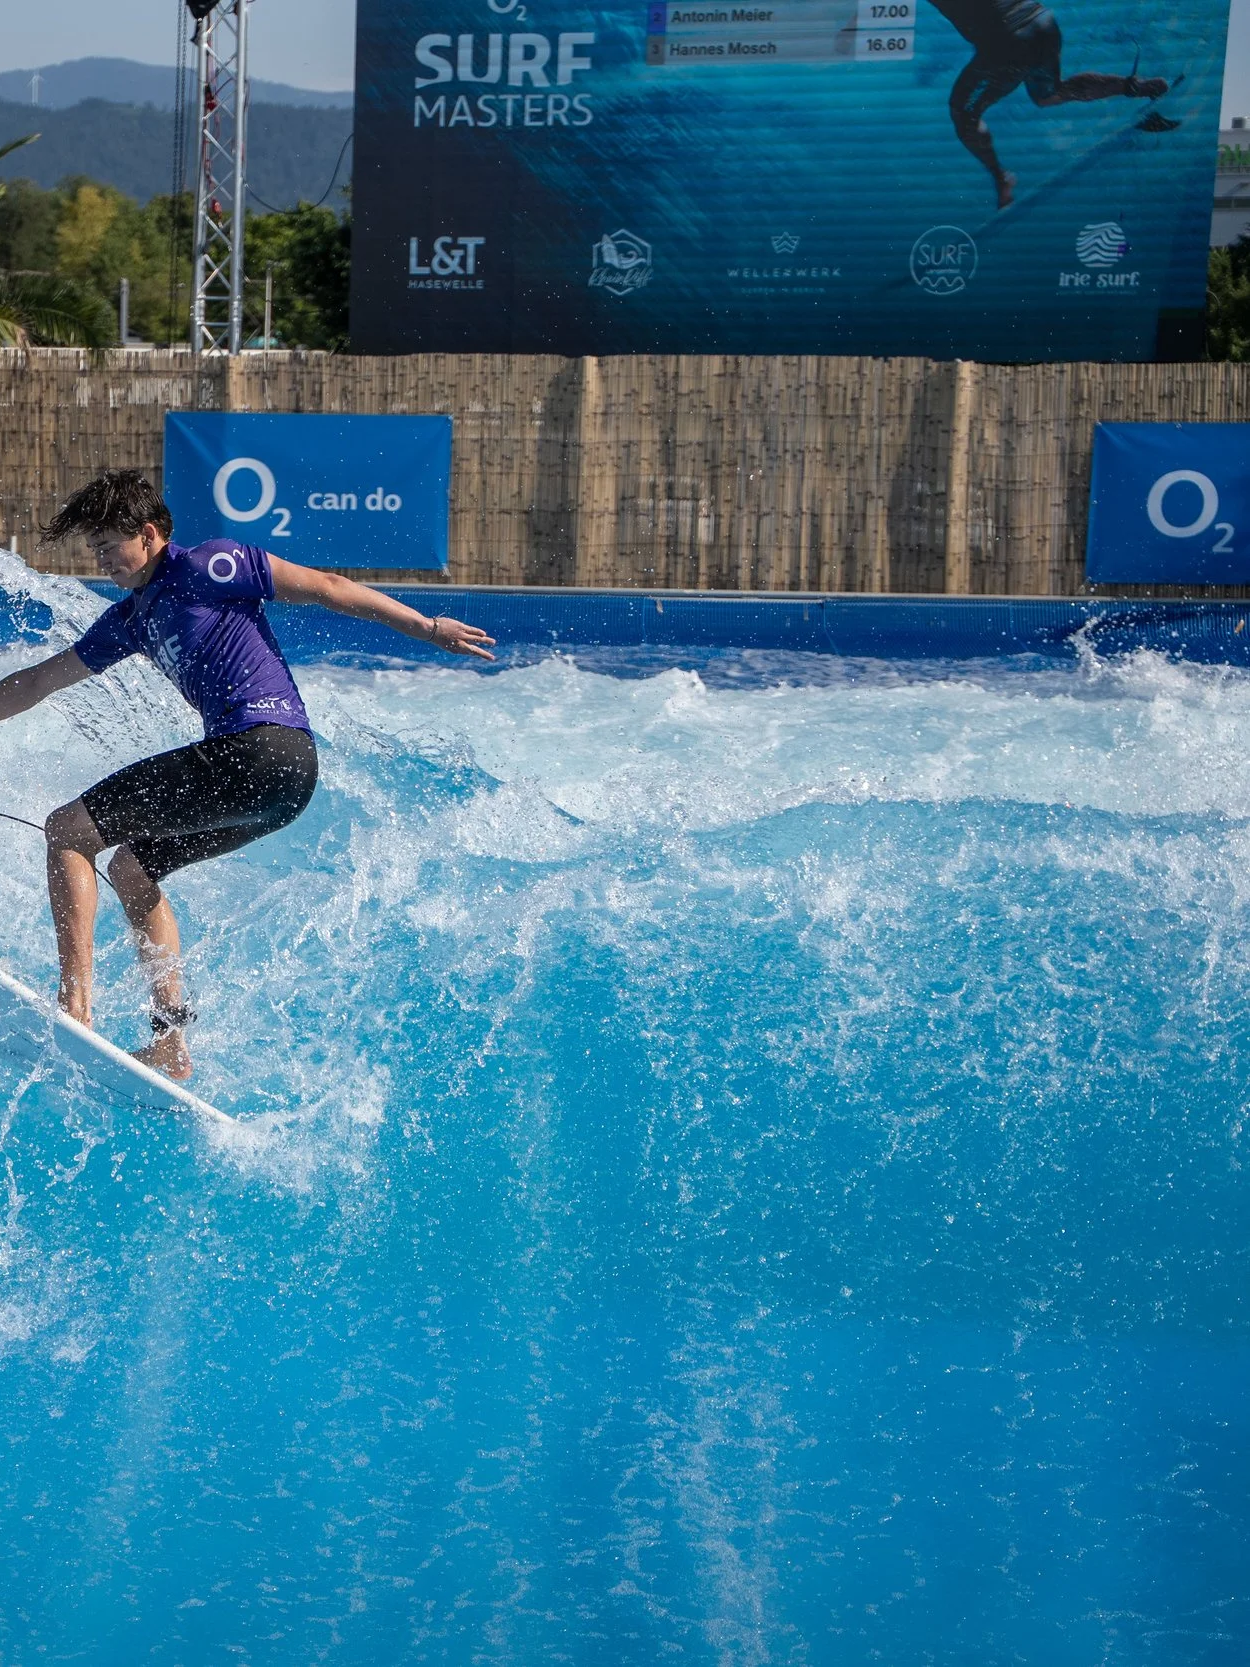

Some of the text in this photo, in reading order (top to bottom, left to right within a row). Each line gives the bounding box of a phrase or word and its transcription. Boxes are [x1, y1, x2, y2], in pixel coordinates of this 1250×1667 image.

[671, 9, 727, 23] Antonin
[731, 8, 773, 22] Meier
[870, 4, 909, 18] 17.00
[652, 38, 906, 56] 3 Hannes Mosch 16.60
[415, 33, 595, 89] SURF
[414, 93, 594, 128] MASTERS
[408, 236, 486, 275] L&T
[918, 243, 970, 266] SURF
[407, 279, 485, 290] HASEWELLE
[1058, 272, 1091, 286] irie
[307, 491, 357, 511] can
[365, 487, 402, 511] do
